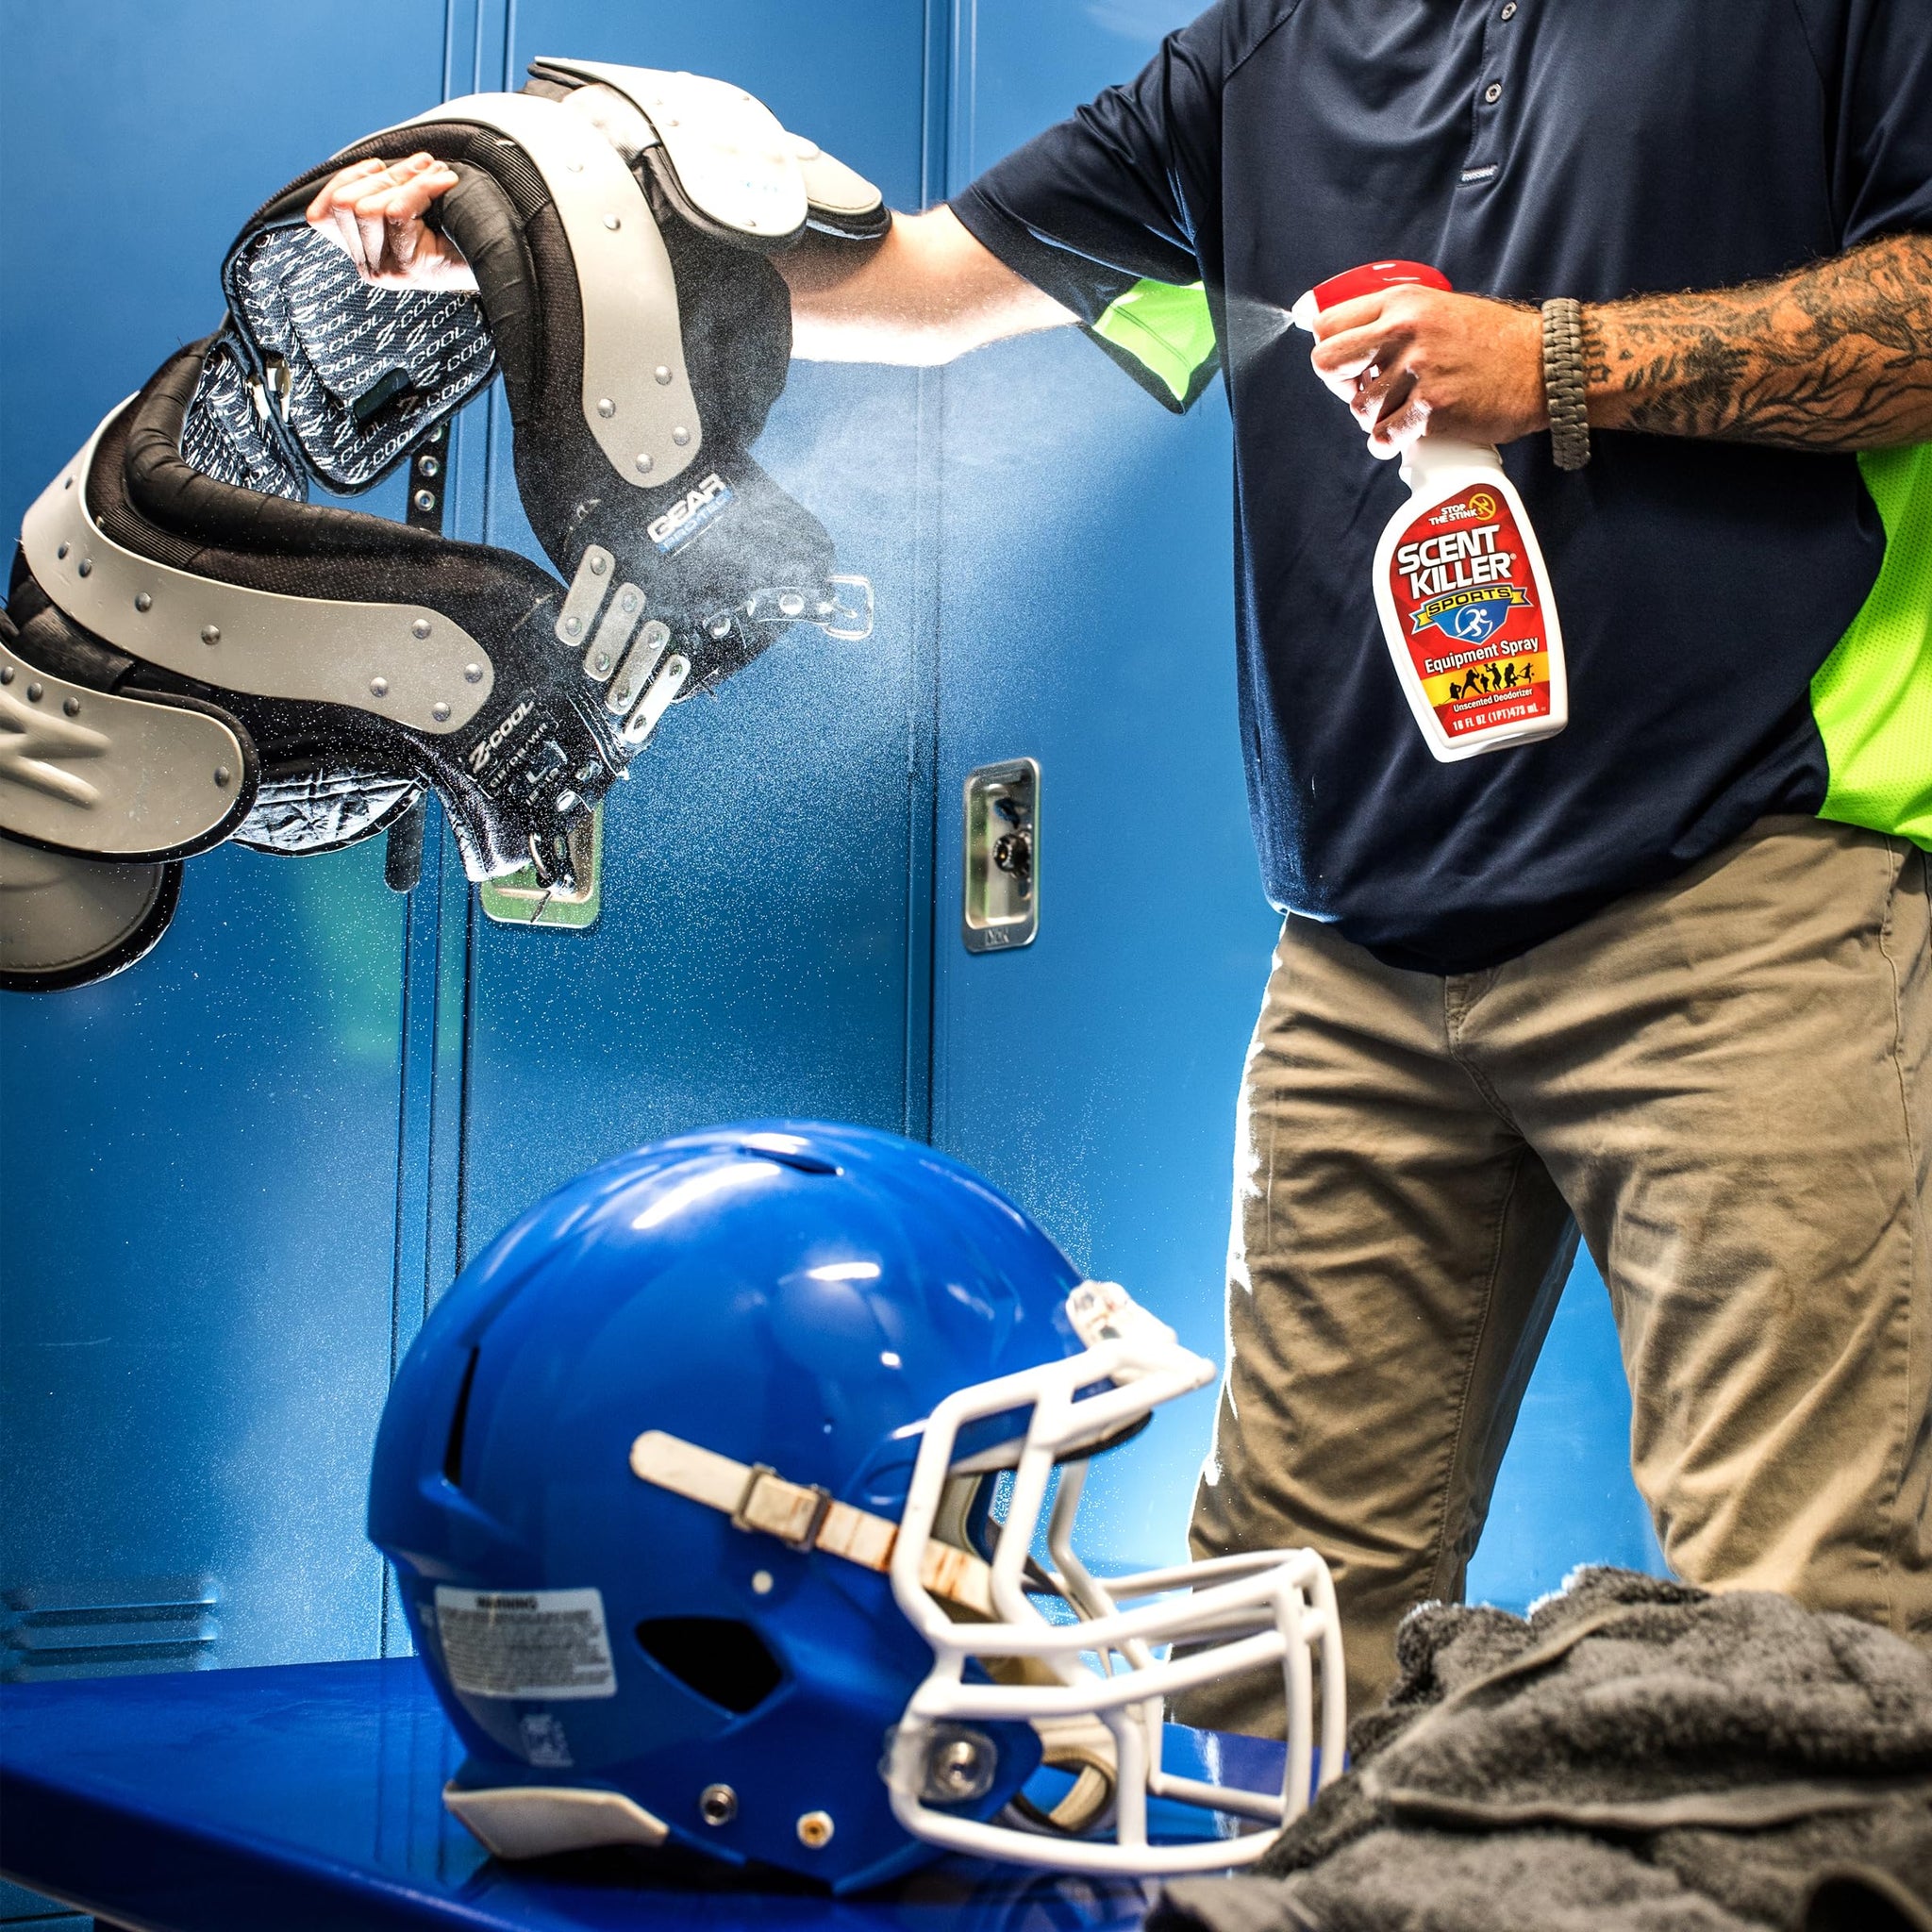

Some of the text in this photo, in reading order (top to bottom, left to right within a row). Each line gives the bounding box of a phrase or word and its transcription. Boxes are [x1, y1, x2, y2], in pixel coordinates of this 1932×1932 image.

[415, 332, 491, 389] Z-COOL
[647, 473, 726, 543] GEAR
[1428, 508, 1478, 526] THE STINK
[1441, 503, 1466, 516] STOP
[1397, 525, 1501, 575] SCENT
[1427, 587, 1511, 616] SPORTS
[1424, 637, 1540, 675] Equipment Spray
[1453, 688, 1533, 713] Unscented Deodorizer
[468, 700, 535, 774] Z-COOL
